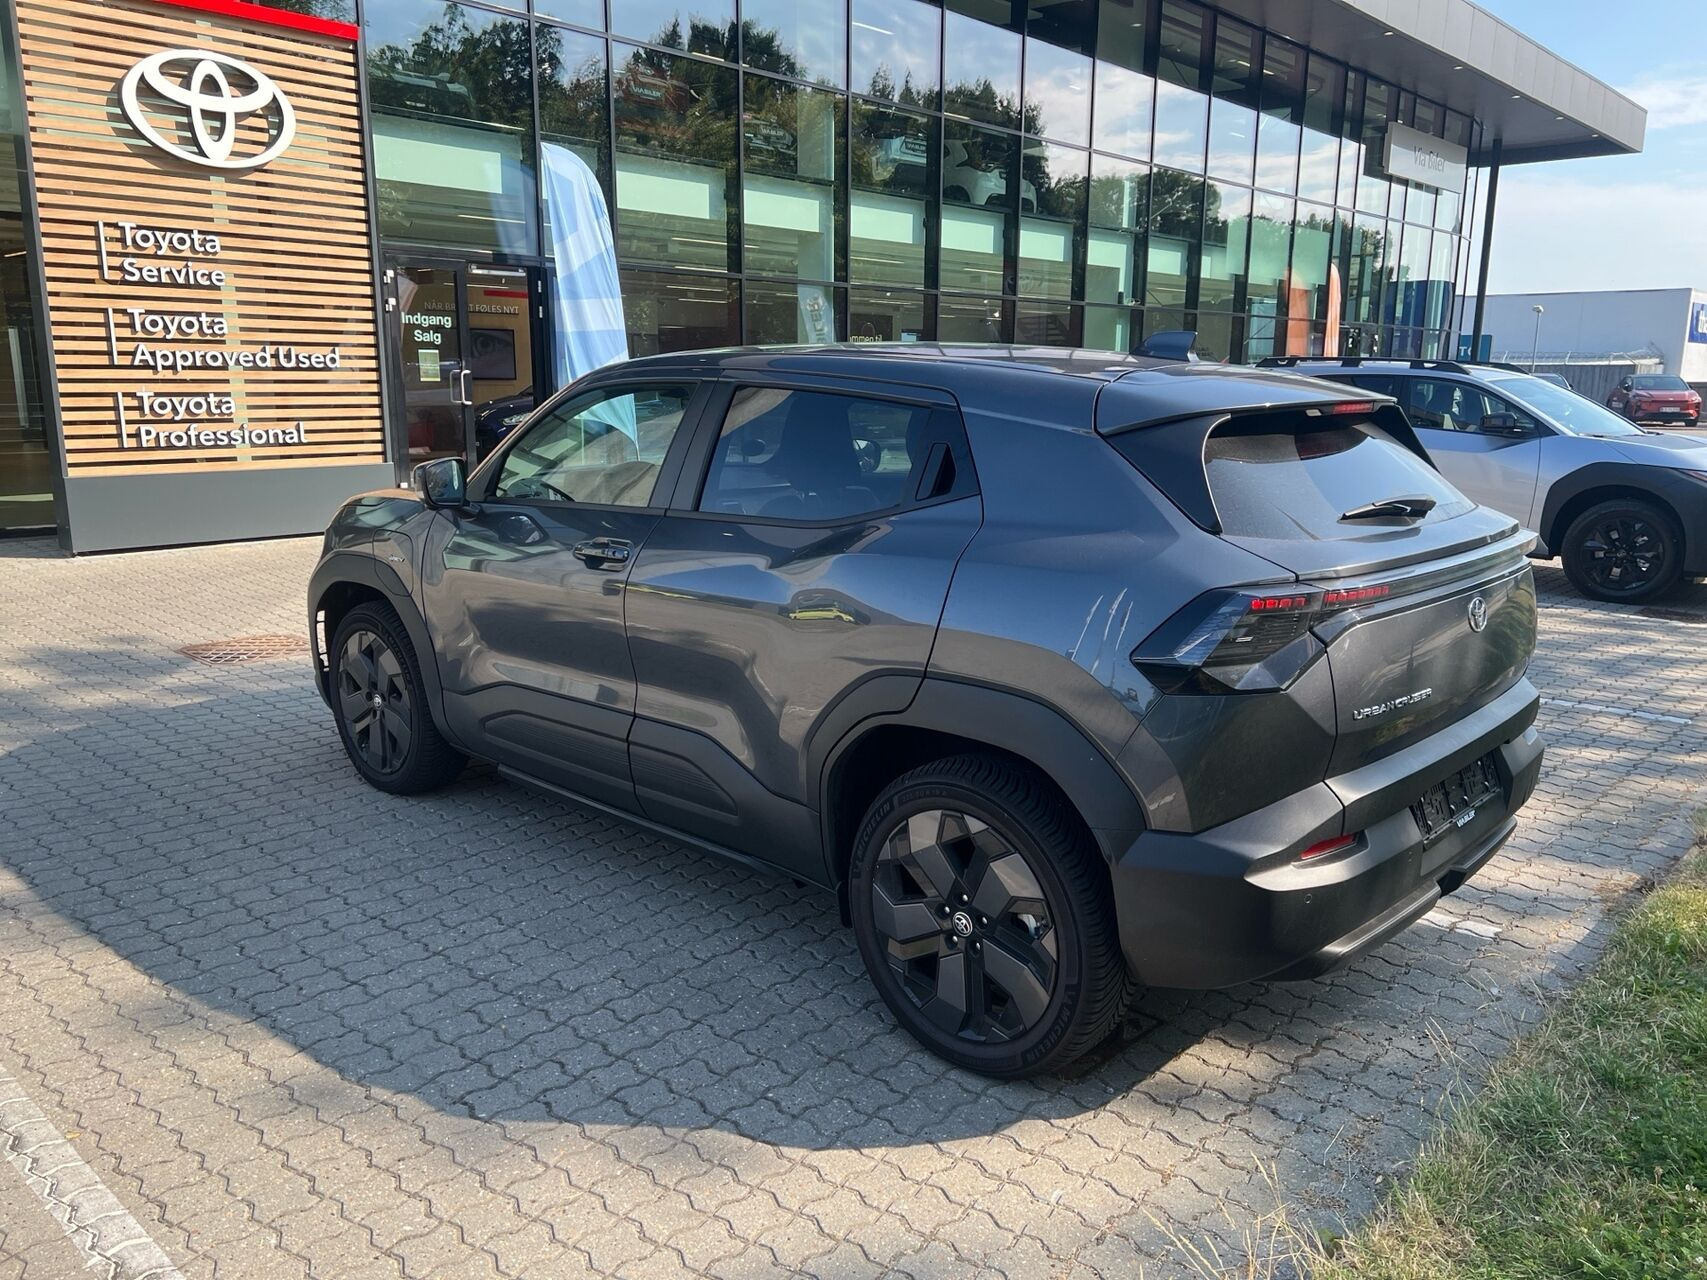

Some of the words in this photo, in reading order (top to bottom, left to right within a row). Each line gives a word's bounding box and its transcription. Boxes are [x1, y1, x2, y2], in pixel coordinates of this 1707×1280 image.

[1413, 146, 1426, 168] Via
[118, 221, 221, 255] Toyota
[122, 258, 226, 286] Service
[401, 311, 453, 329] Indgang
[475, 304, 502, 314] FØLES
[503, 306, 519, 314] NYT
[127, 308, 229, 339] Toyota
[413, 329, 442, 345] Salg
[133, 344, 271, 372] Approved
[278, 346, 341, 368] Used
[136, 391, 236, 420] Toyota
[139, 421, 308, 448] Professional
